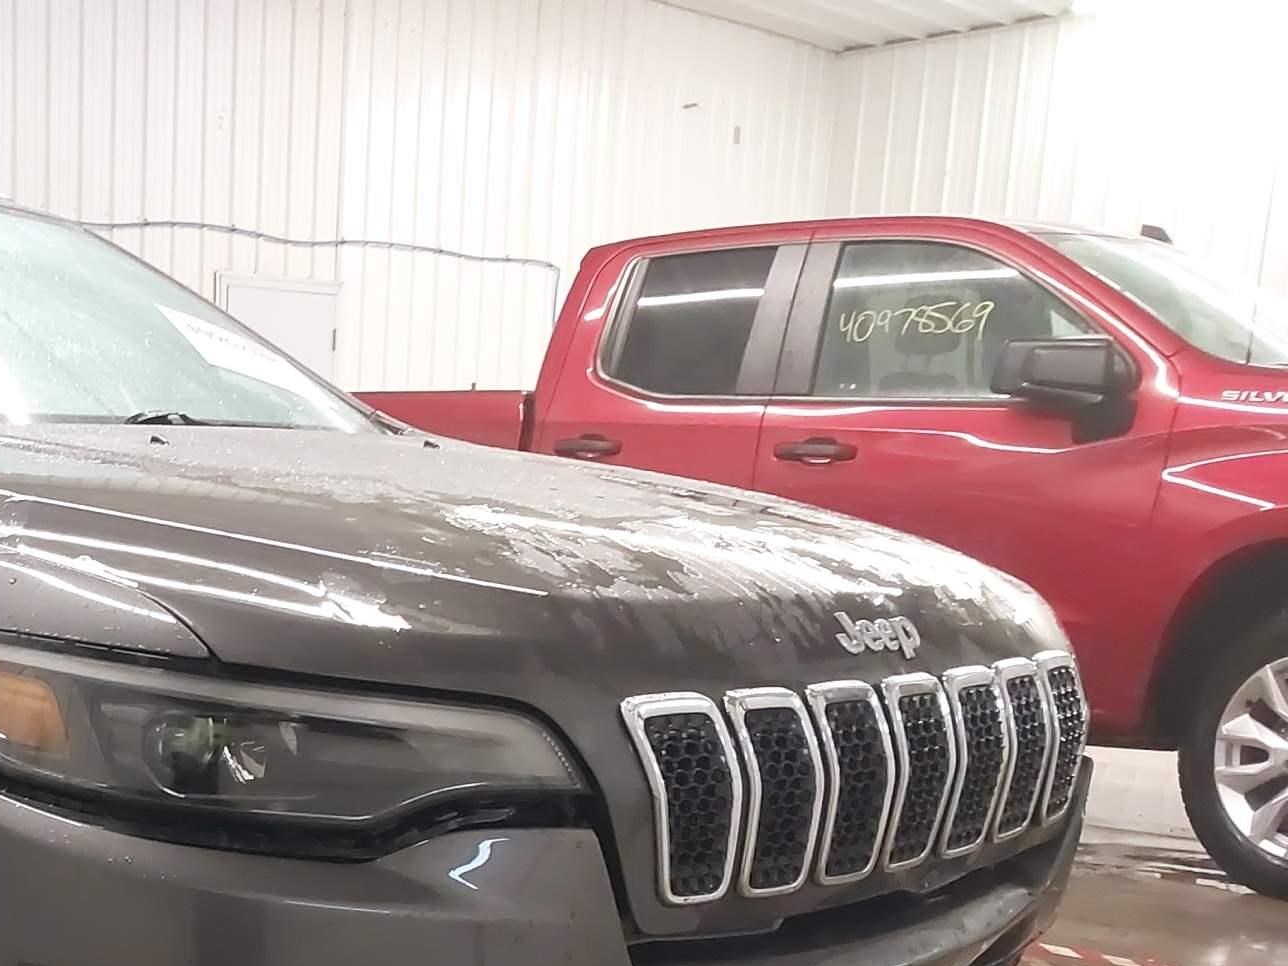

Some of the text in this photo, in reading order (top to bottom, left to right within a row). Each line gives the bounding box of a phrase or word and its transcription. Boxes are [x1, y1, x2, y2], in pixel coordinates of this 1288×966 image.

[839, 301, 995, 342] 40978569
[1220, 389, 1288, 403] SILV
[833, 611, 921, 660] Jeep
